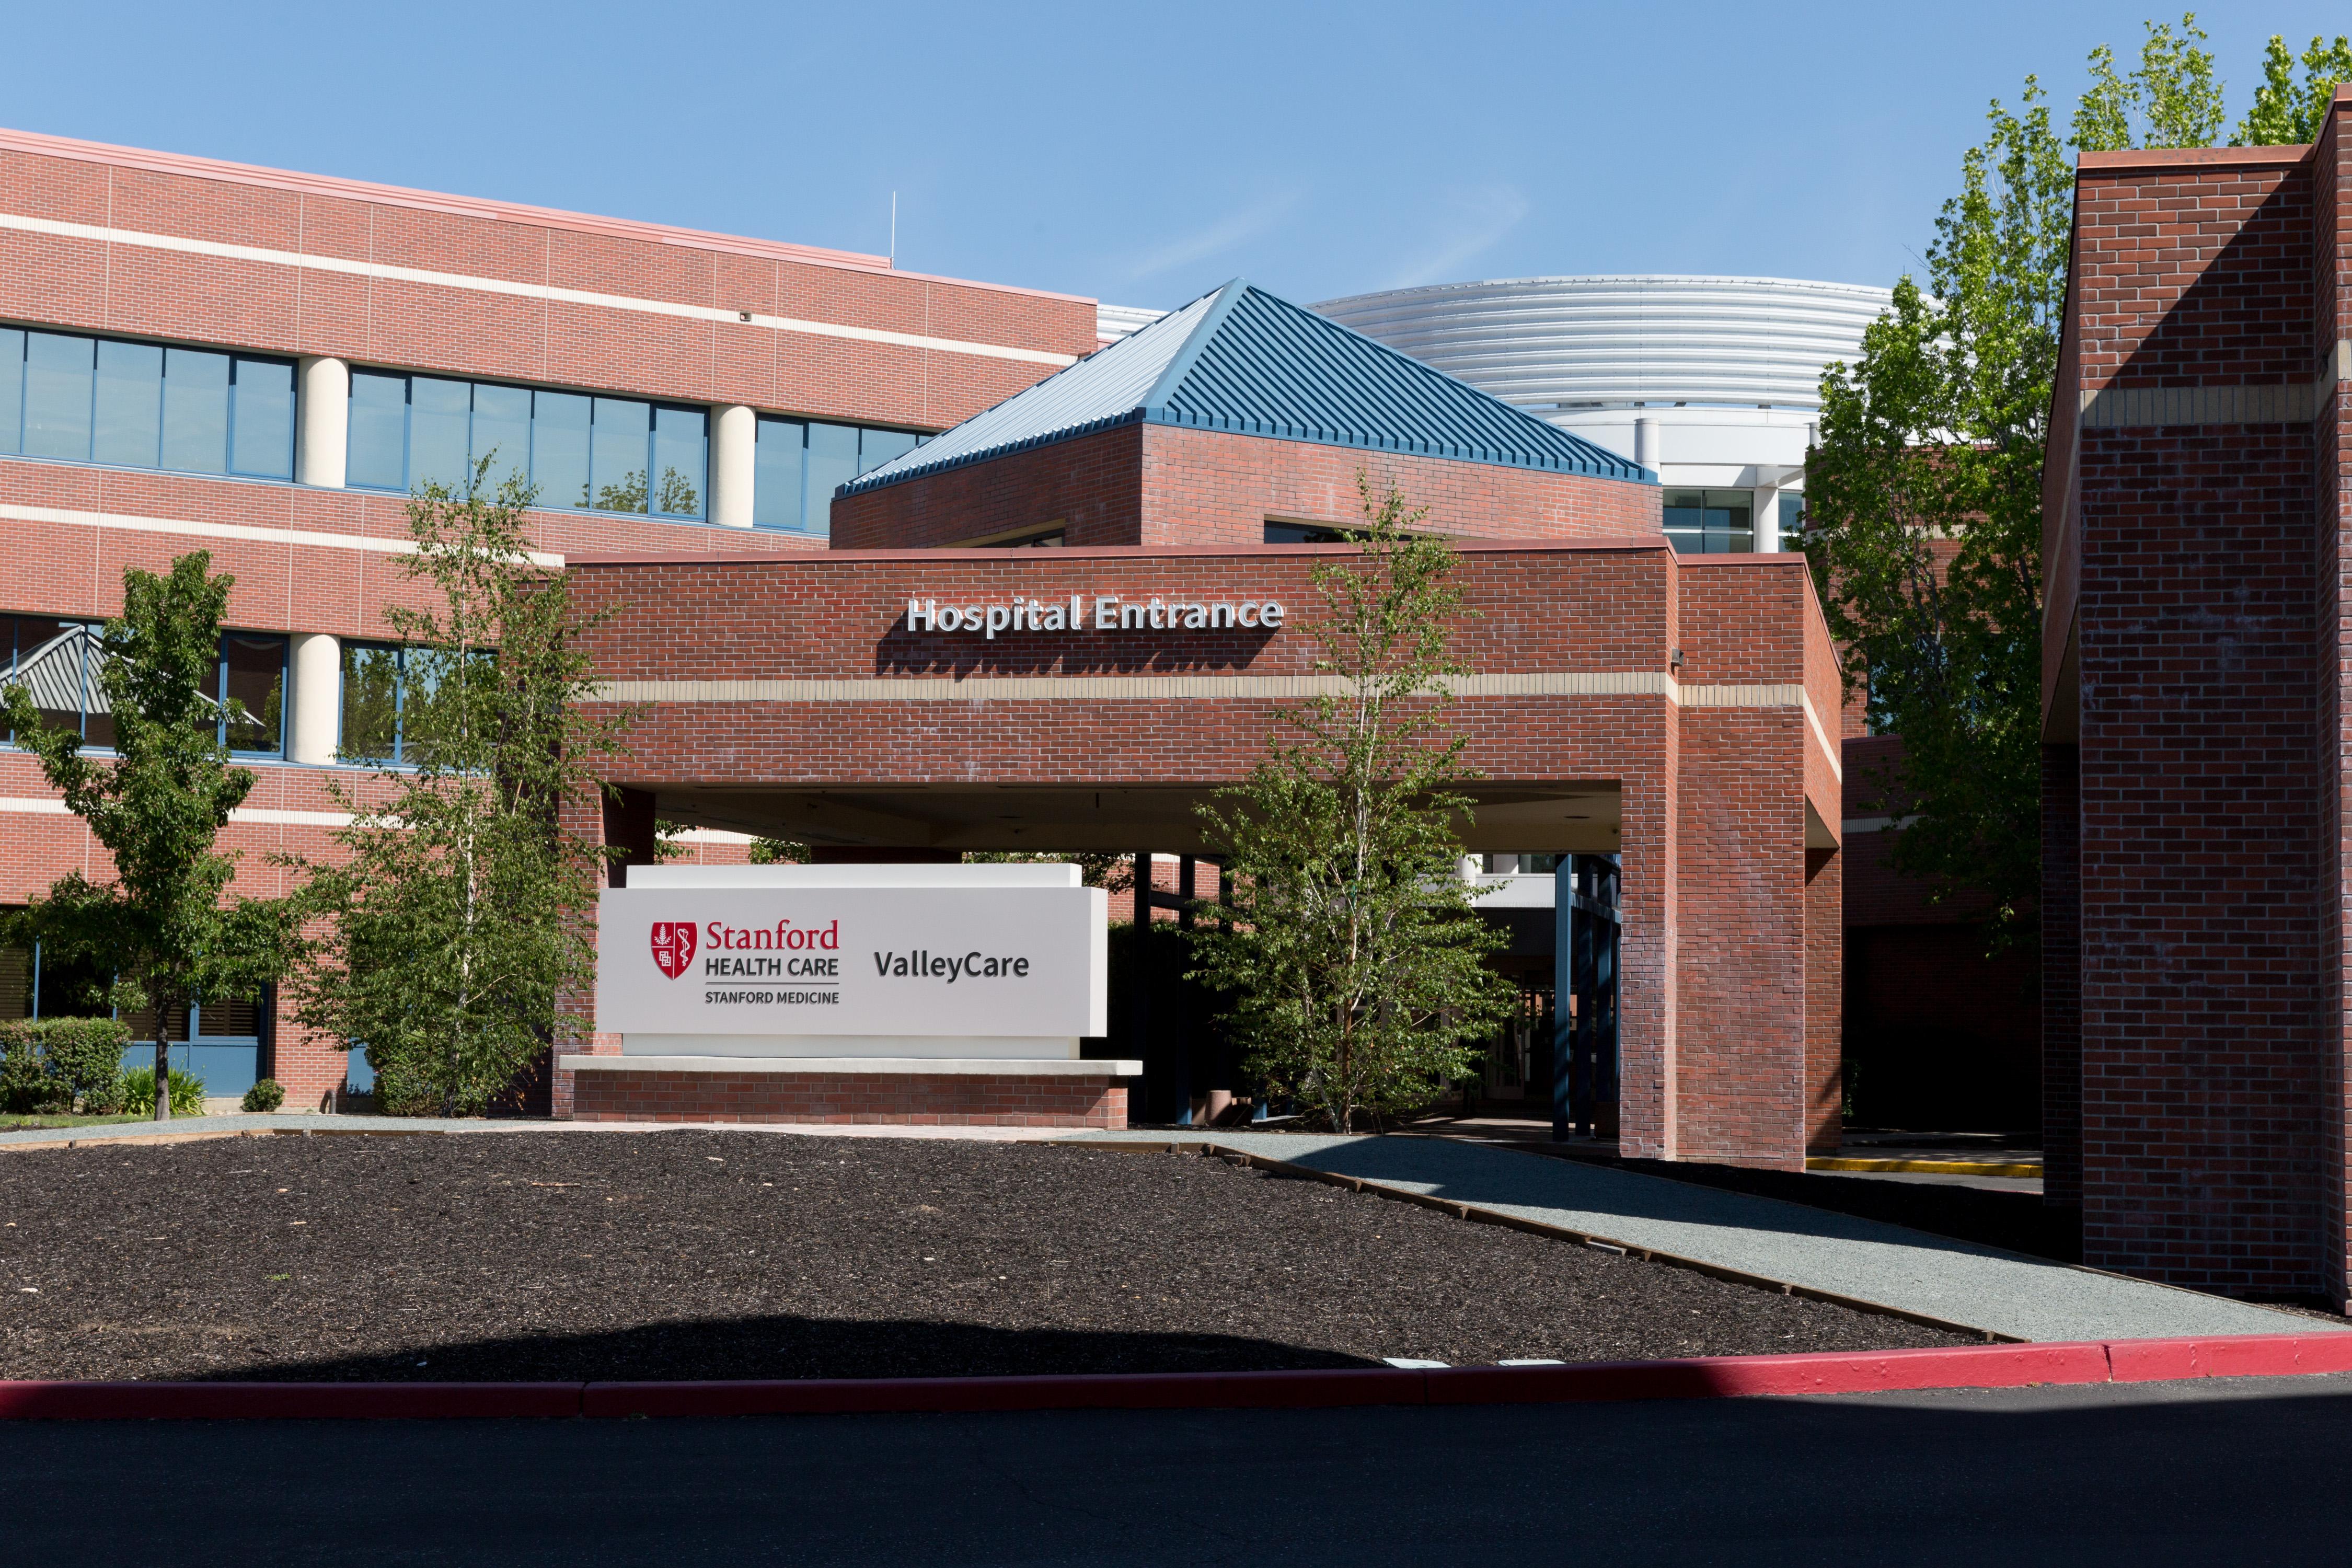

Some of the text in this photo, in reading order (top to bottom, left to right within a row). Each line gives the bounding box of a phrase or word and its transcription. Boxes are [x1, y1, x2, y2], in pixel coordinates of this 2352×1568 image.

[907, 595, 1284, 639] Hospital Entrance
[706, 918, 839, 950] Stanford
[706, 958, 839, 976] HEALTH CARE
[874, 950, 1030, 984] ValleyCare
[705, 991, 839, 1004] STANFORD MEDICINE
